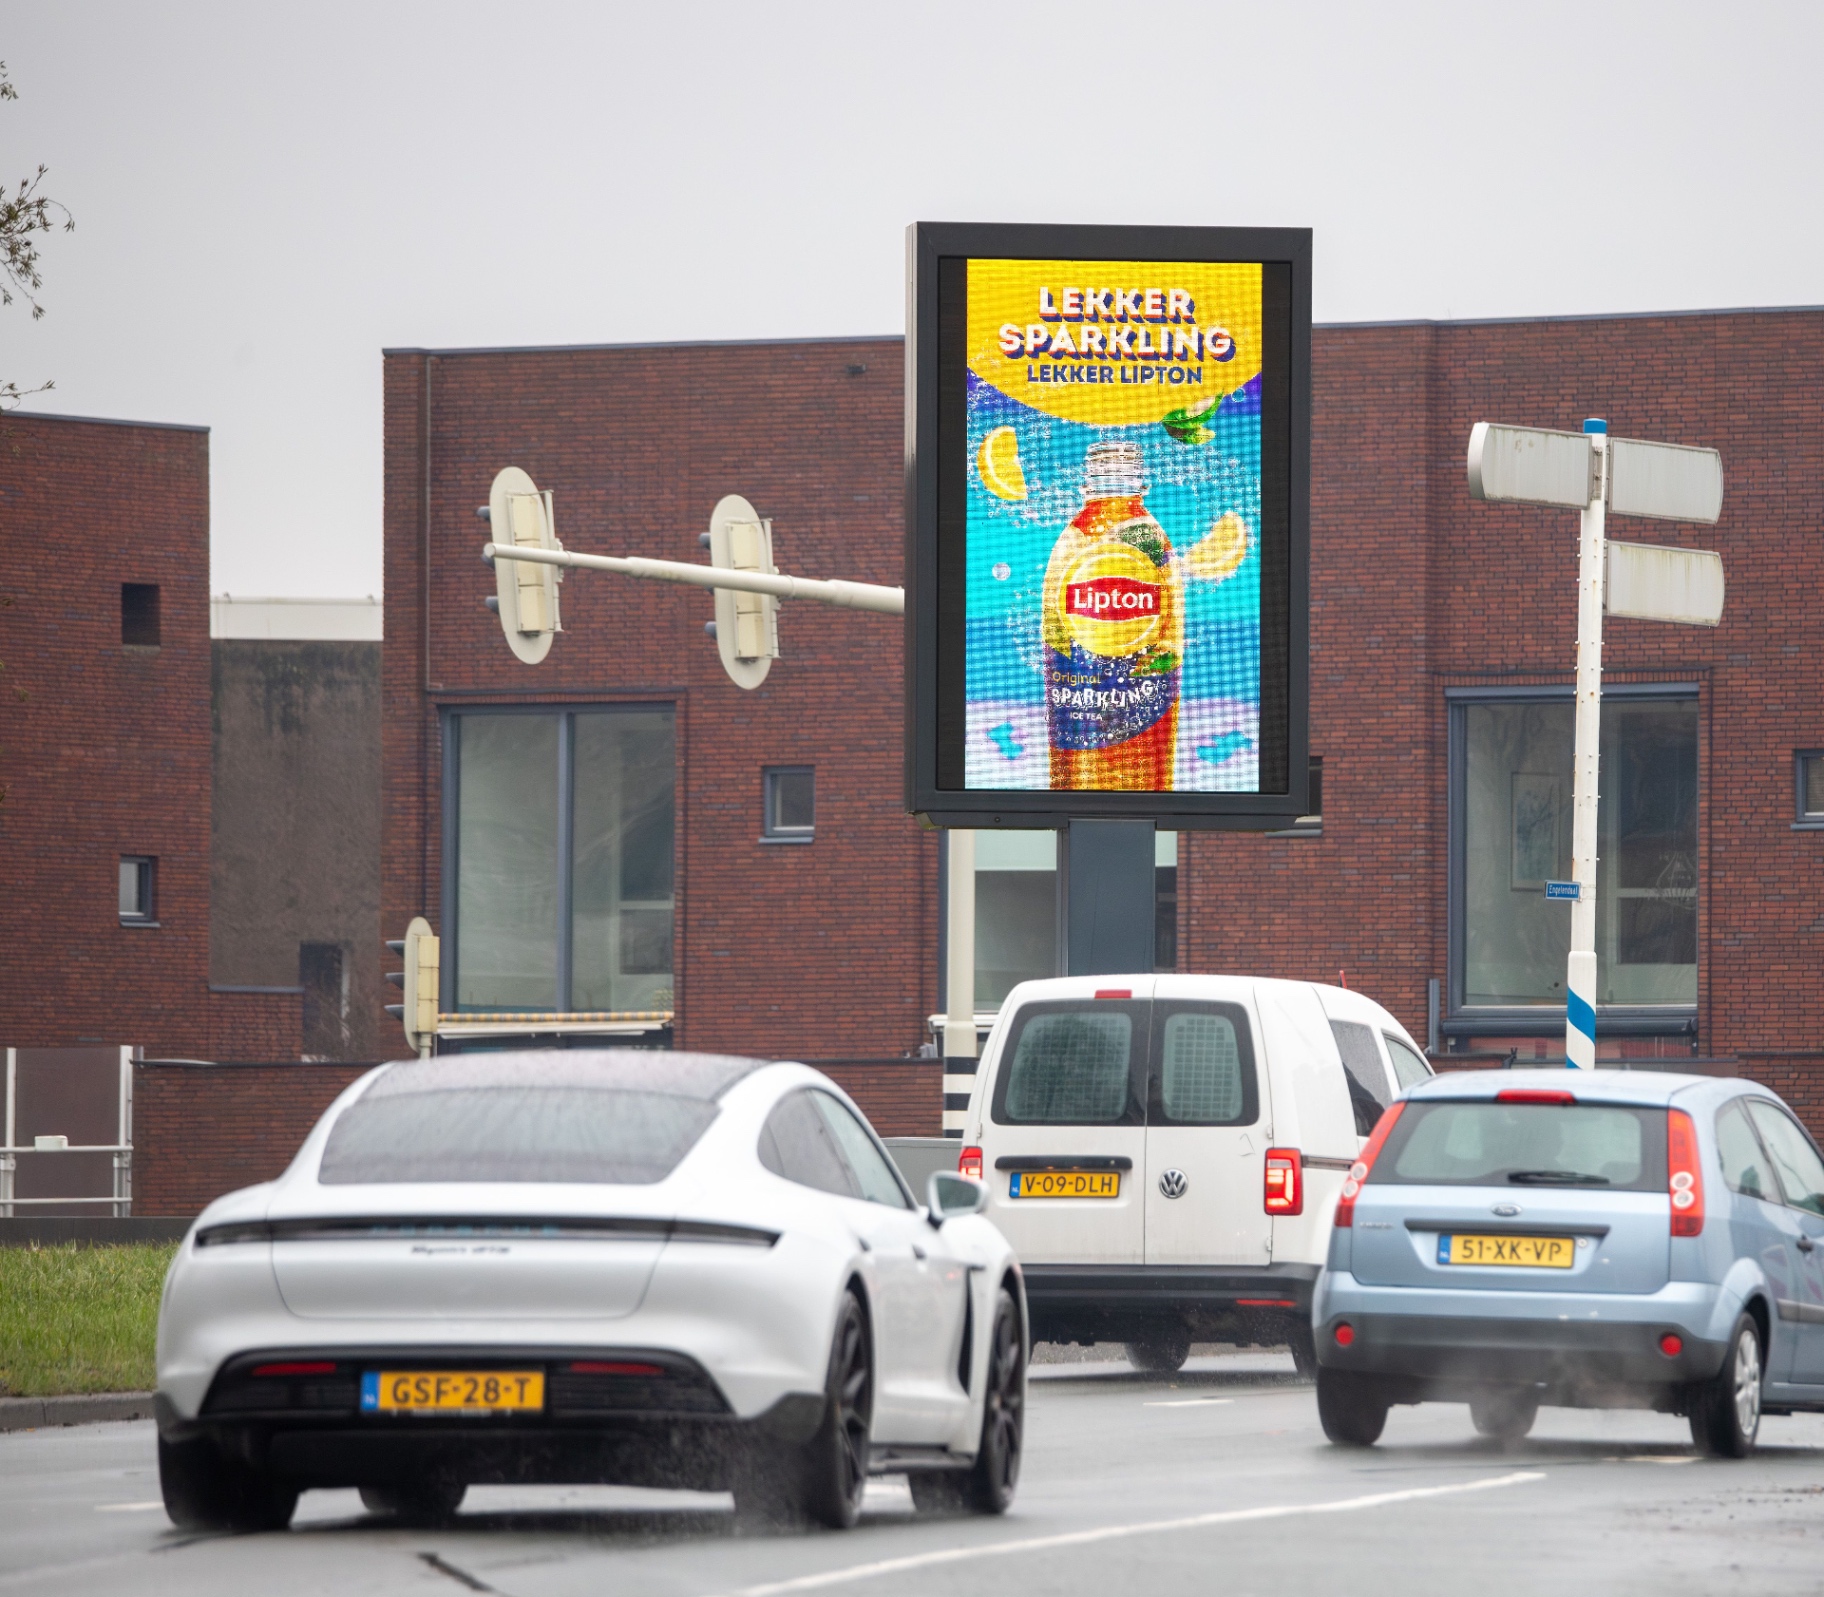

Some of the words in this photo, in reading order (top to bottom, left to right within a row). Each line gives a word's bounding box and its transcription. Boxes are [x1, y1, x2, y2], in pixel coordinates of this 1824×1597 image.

[1039, 286, 1196, 324] LEKKER
[998, 323, 1237, 362] SPARKLING
[1027, 364, 1114, 383] LEKKER
[1121, 365, 1203, 384] LIPTON
[1073, 587, 1154, 613] Lipton
[1052, 671, 1102, 686] Original
[1052, 680, 1154, 707] SPARKLING
[1070, 711, 1083, 720] ICE
[1086, 712, 1103, 720] TEA
[1024, 1175, 1114, 1193] V-09-DLH
[1461, 1239, 1562, 1262] 51-XK-VP
[392, 1377, 532, 1405] GSF-28-T
